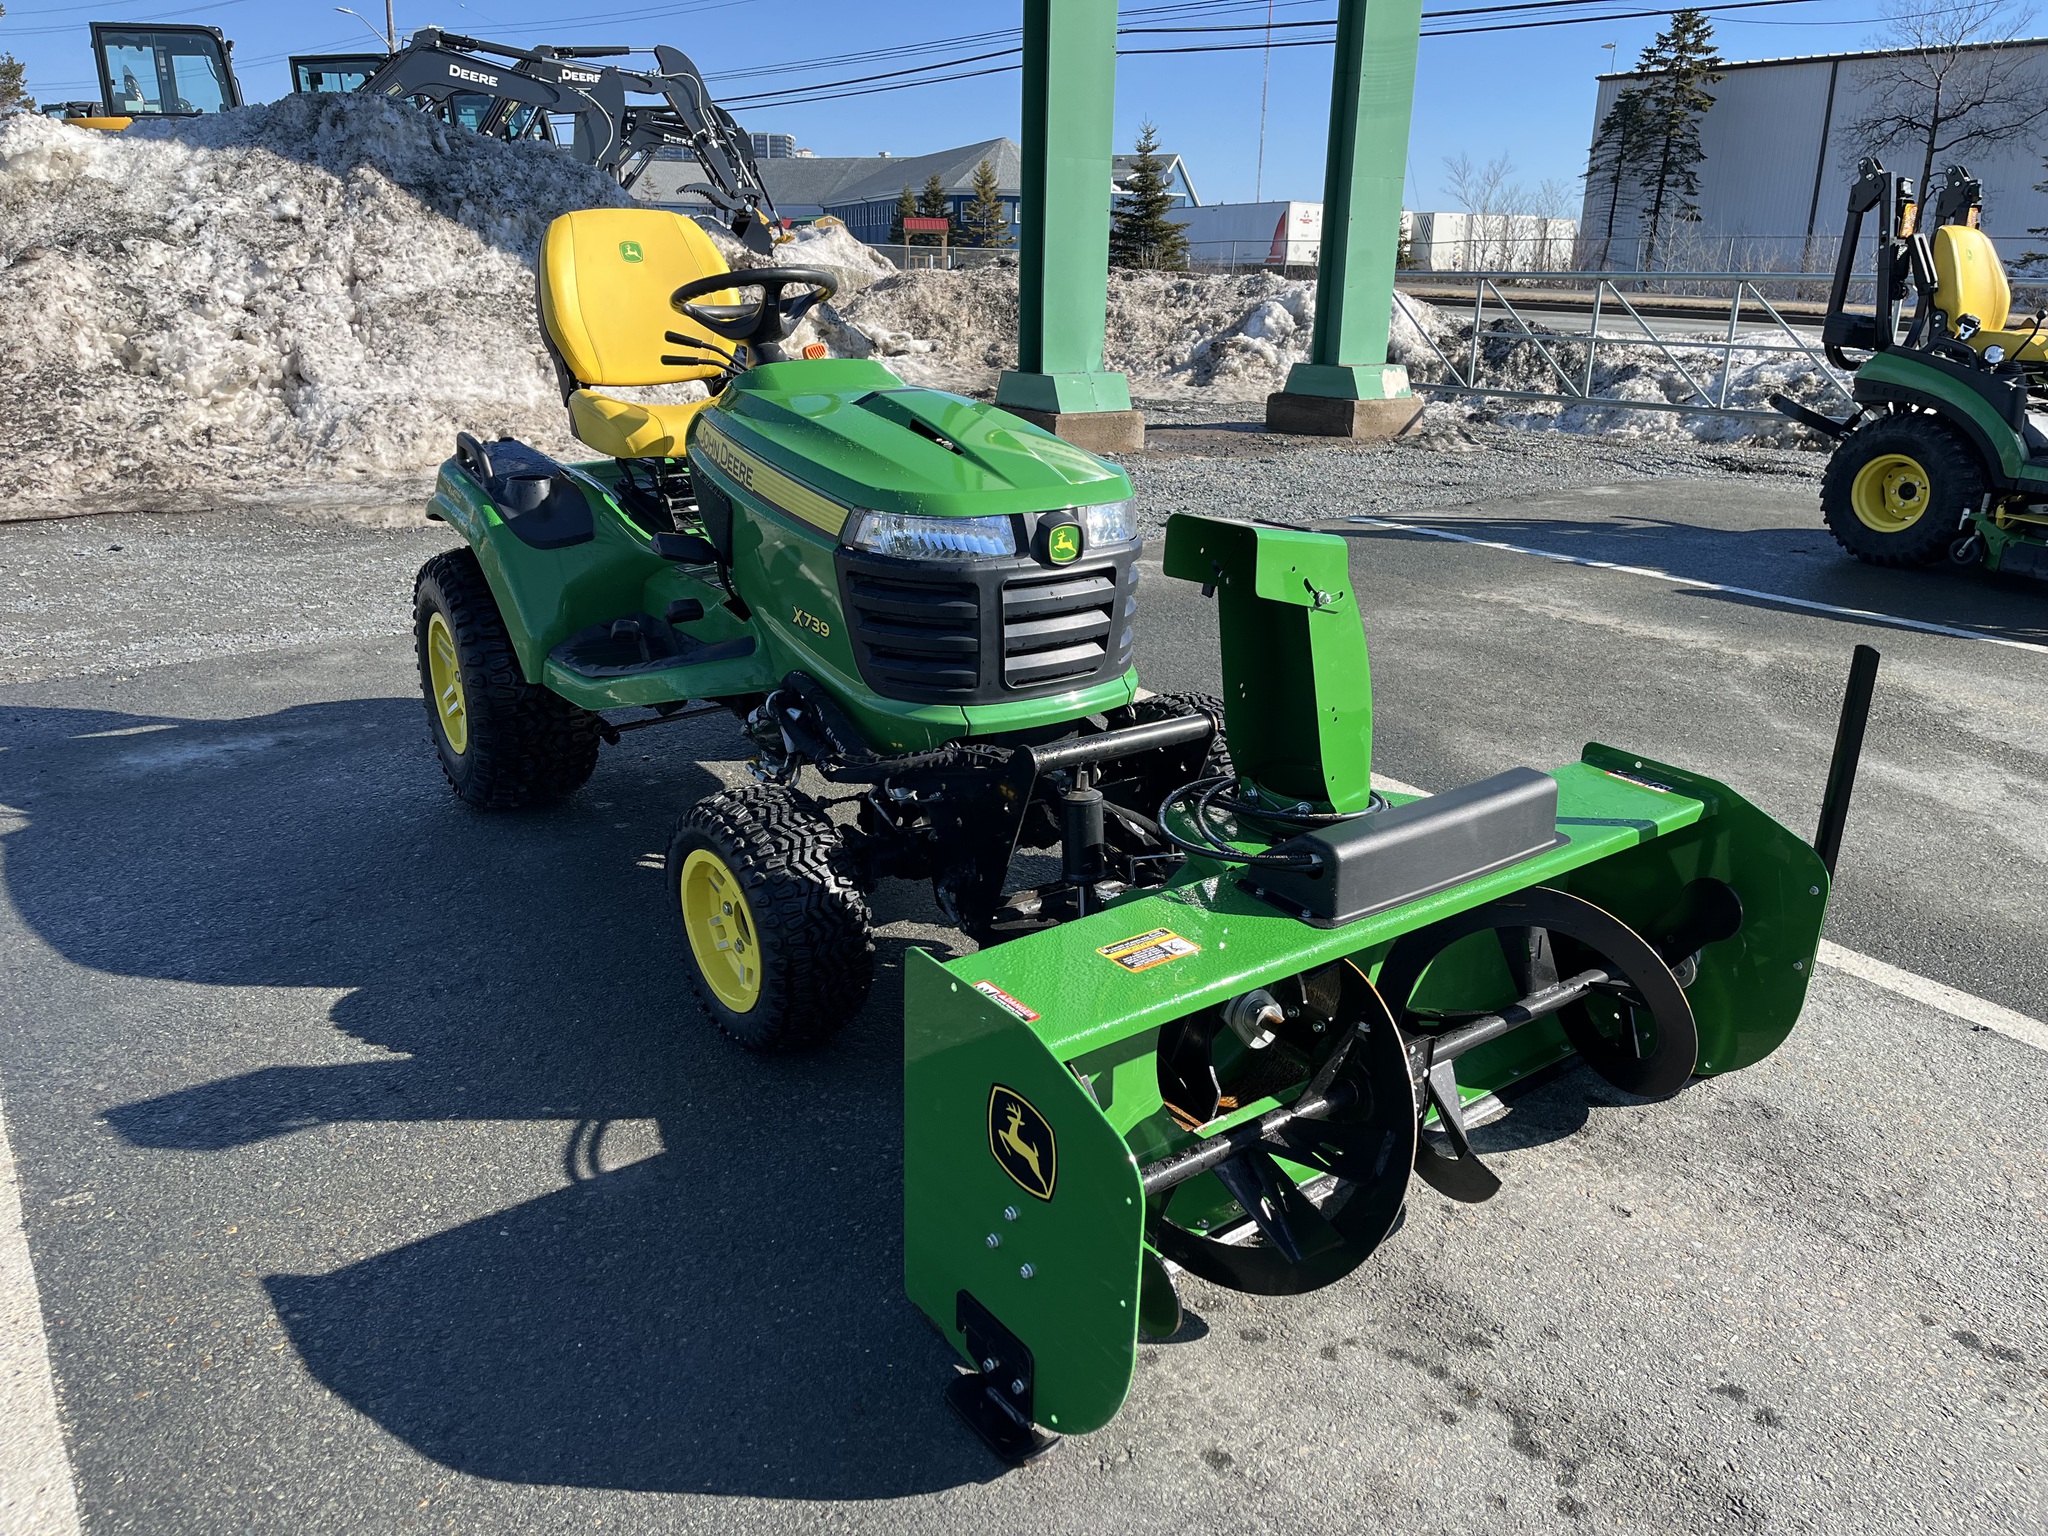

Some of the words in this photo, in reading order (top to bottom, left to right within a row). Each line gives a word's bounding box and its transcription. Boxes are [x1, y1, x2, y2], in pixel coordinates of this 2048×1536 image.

[448, 63, 498, 87] DEERE
[663, 133, 694, 147] DEERE
[700, 427, 720, 463] JOHN
[720, 444, 754, 490] DEERE
[792, 605, 830, 638] X739
[1005, 996, 1037, 1018] DANGER
